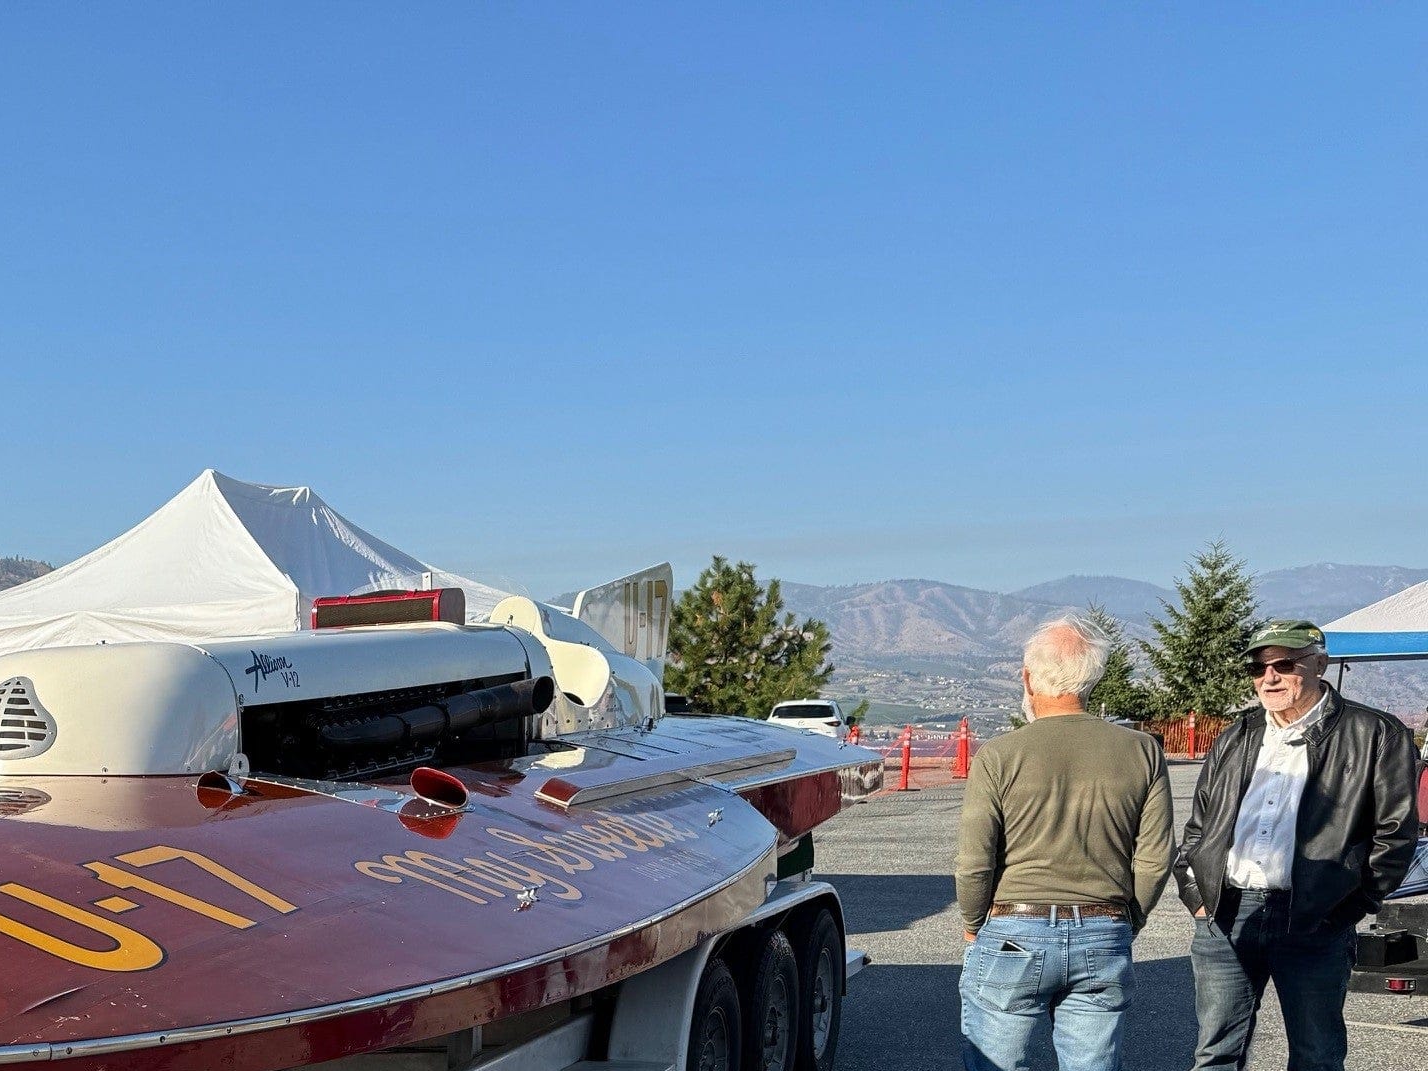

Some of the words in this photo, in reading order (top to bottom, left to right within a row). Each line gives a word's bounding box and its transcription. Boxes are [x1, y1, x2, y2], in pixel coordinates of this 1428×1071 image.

[624, 579, 668, 661] U-17
[245, 649, 293, 692] Allison
[353, 849, 583, 902] My
